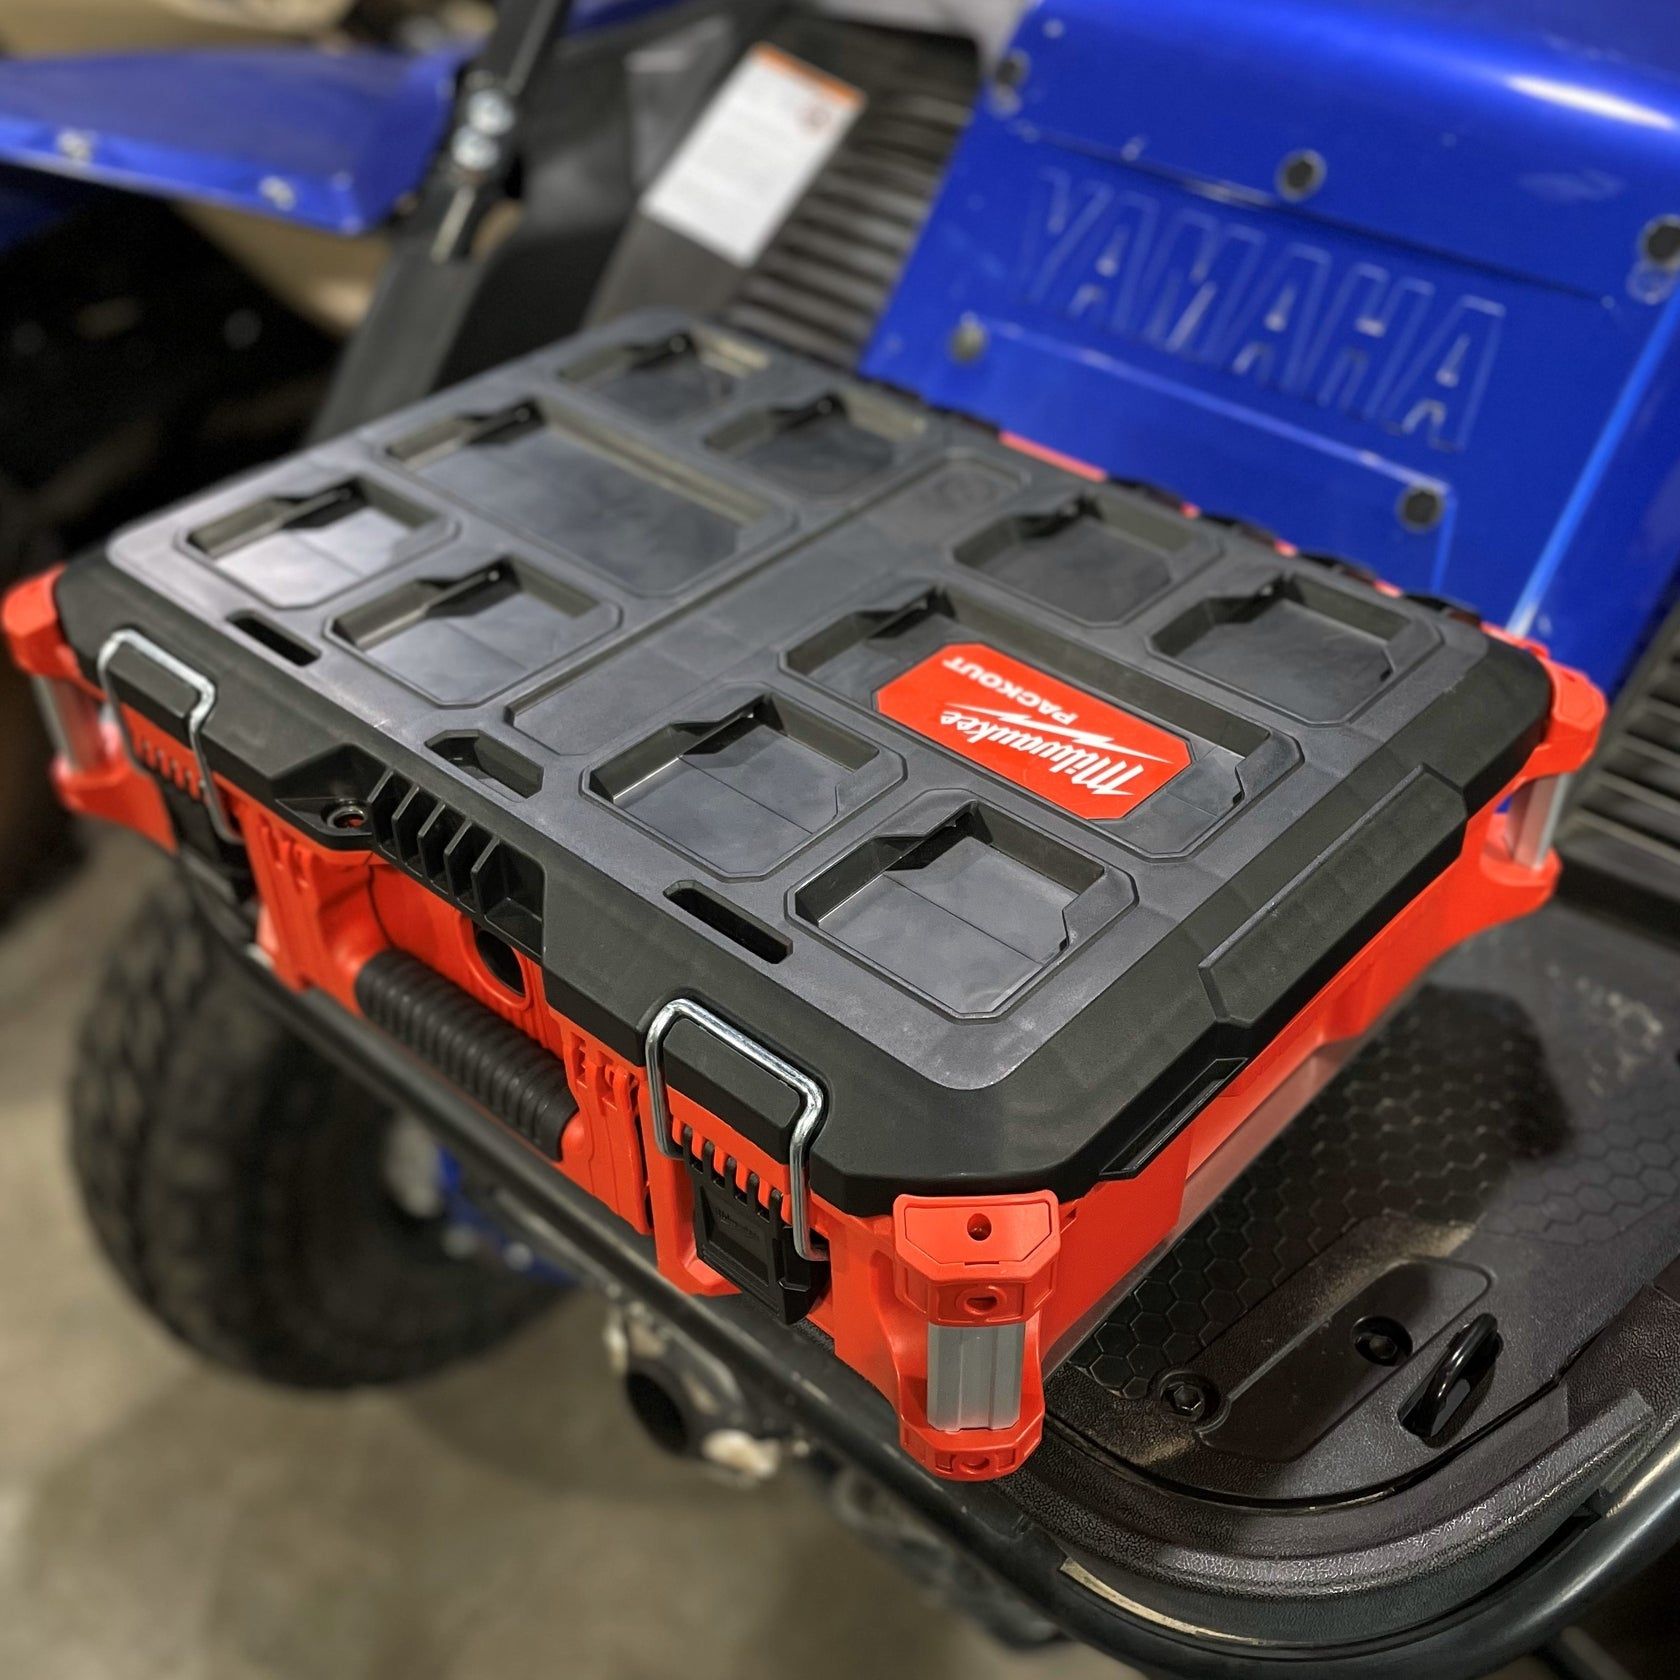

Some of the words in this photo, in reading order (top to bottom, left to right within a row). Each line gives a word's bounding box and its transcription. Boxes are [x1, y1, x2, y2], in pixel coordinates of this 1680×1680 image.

[1018, 168, 1505, 450] YAMAHA
[941, 656, 1078, 725] PACKOUT
[939, 710, 1144, 796] Milwaukee
